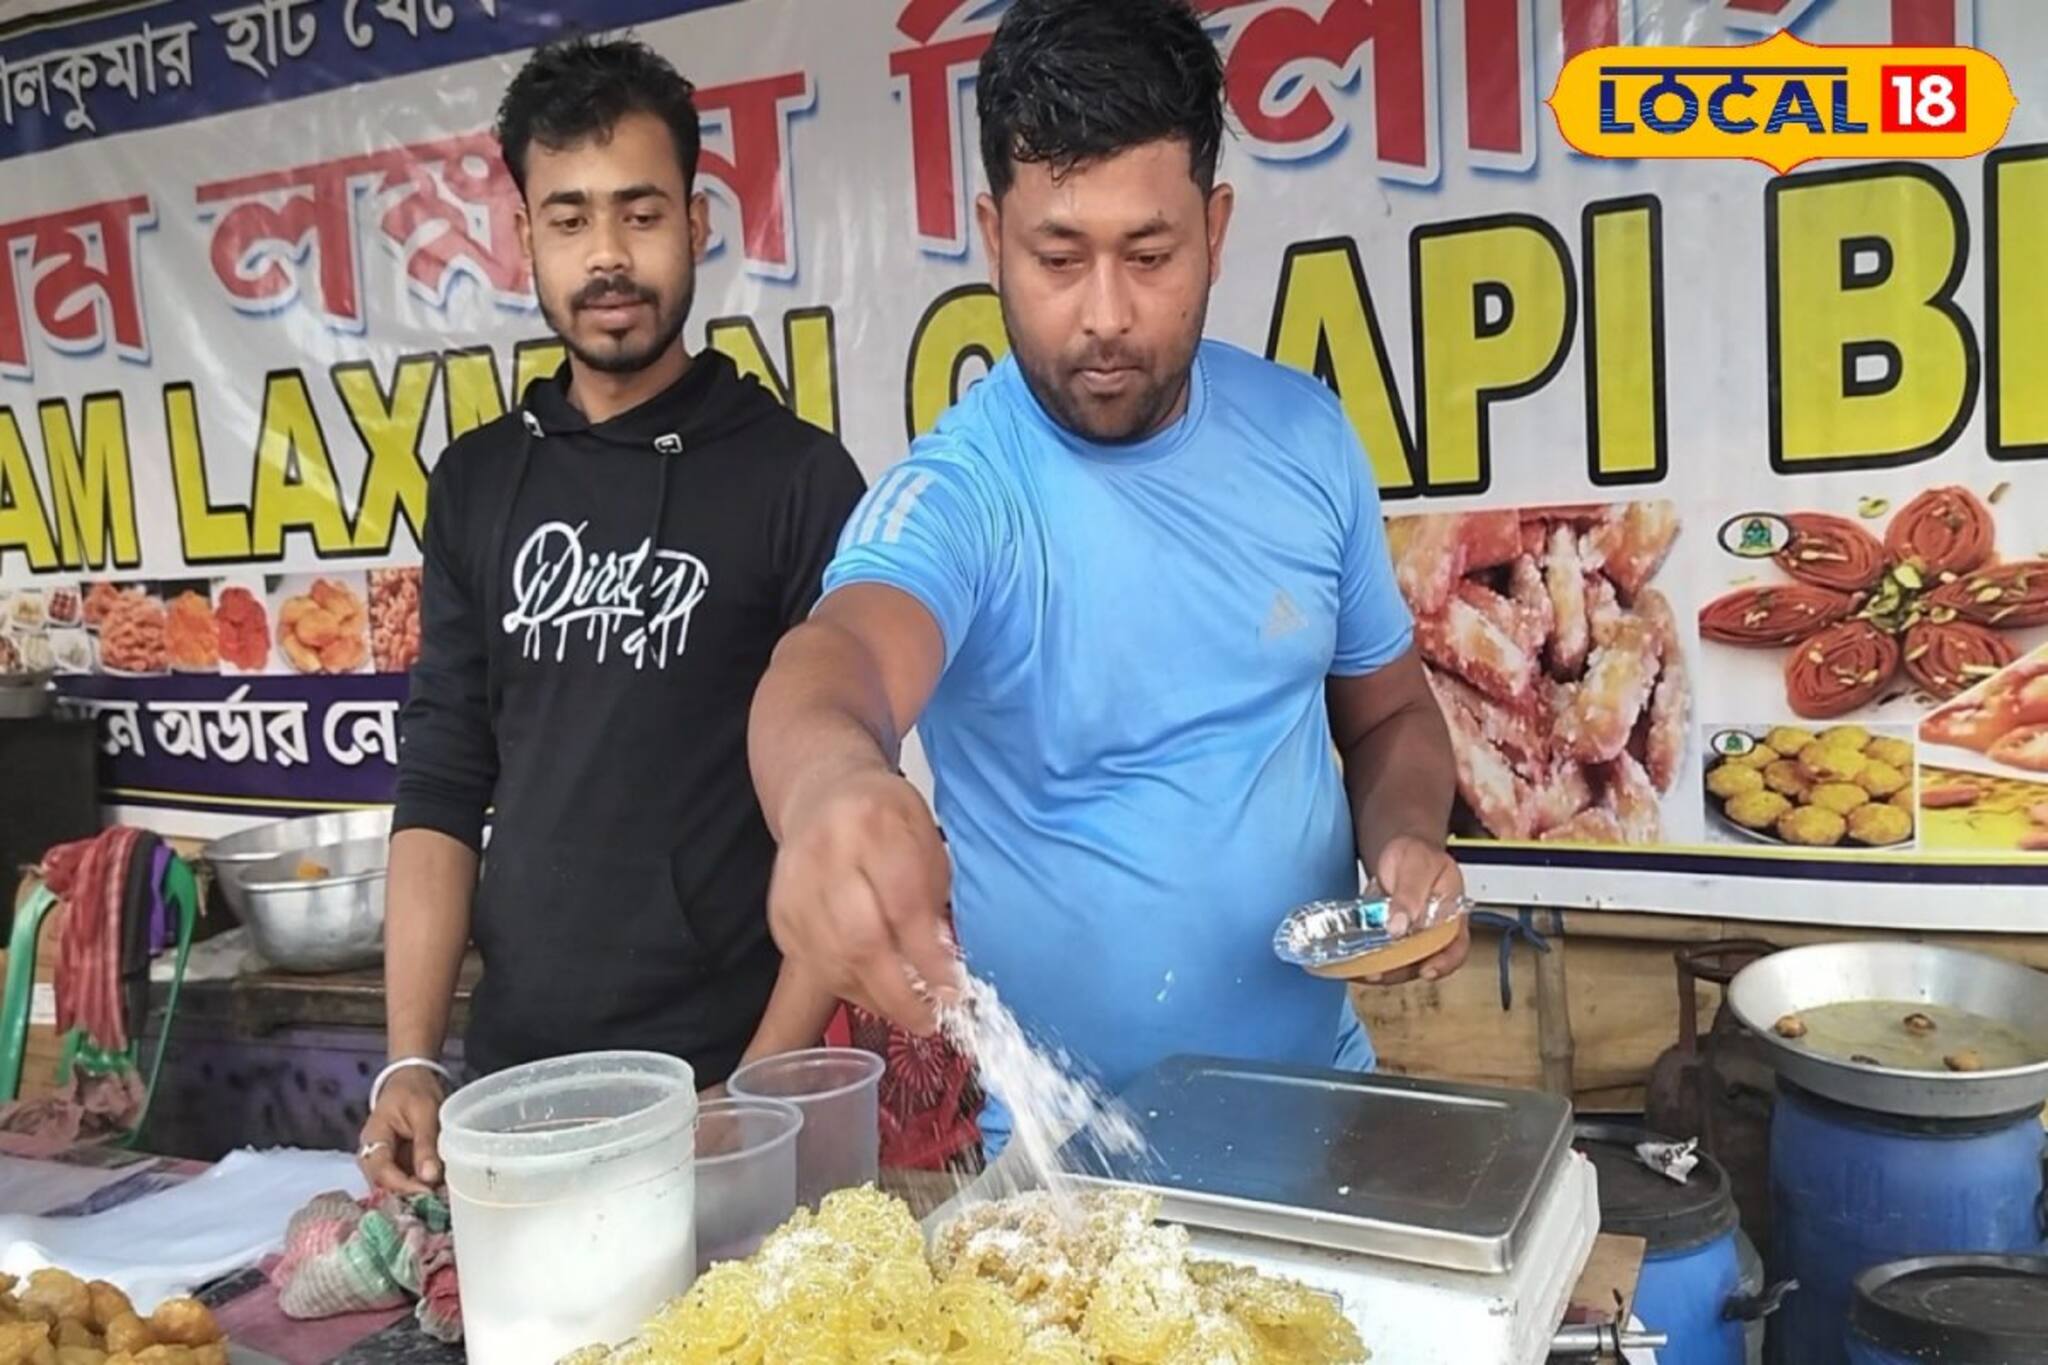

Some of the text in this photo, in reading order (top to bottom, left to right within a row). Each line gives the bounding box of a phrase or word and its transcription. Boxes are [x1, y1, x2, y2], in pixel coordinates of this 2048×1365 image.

[163, 304, 838, 566] LAXN
[147, 684, 310, 767] অর্ডার
[322, 701, 408, 766] নে
